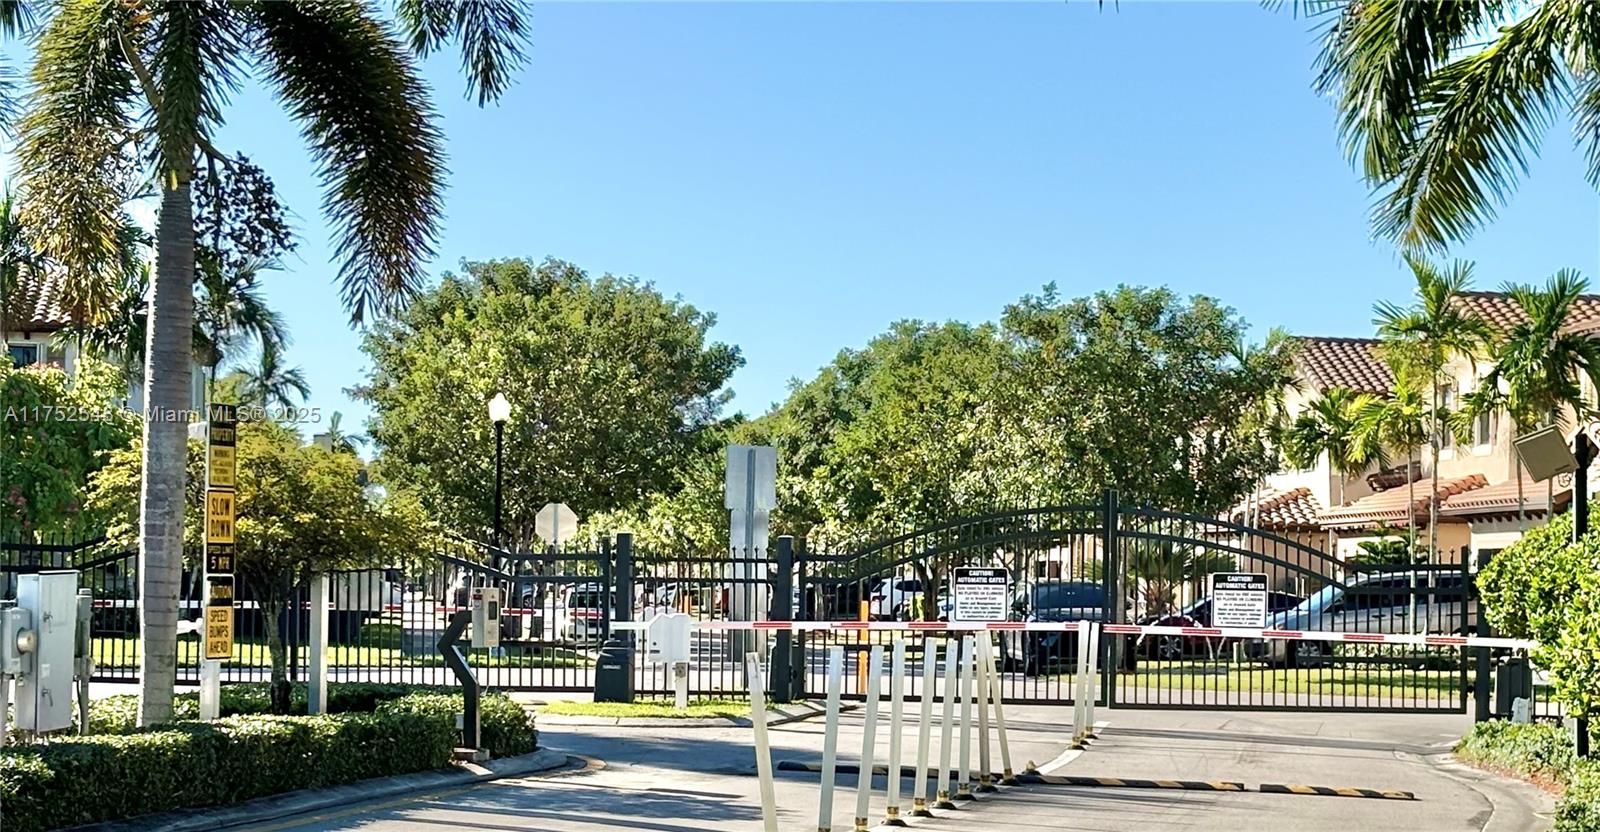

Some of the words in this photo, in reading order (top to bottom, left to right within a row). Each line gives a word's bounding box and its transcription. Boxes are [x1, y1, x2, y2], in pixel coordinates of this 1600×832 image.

[212, 497, 230, 516] SLOW
[210, 519, 231, 537] DOWN
[211, 556, 217, 570] 5
[210, 609, 228, 623] SPEED
[209, 625, 229, 639] BUMPS
[210, 640, 228, 654] AHEAD
